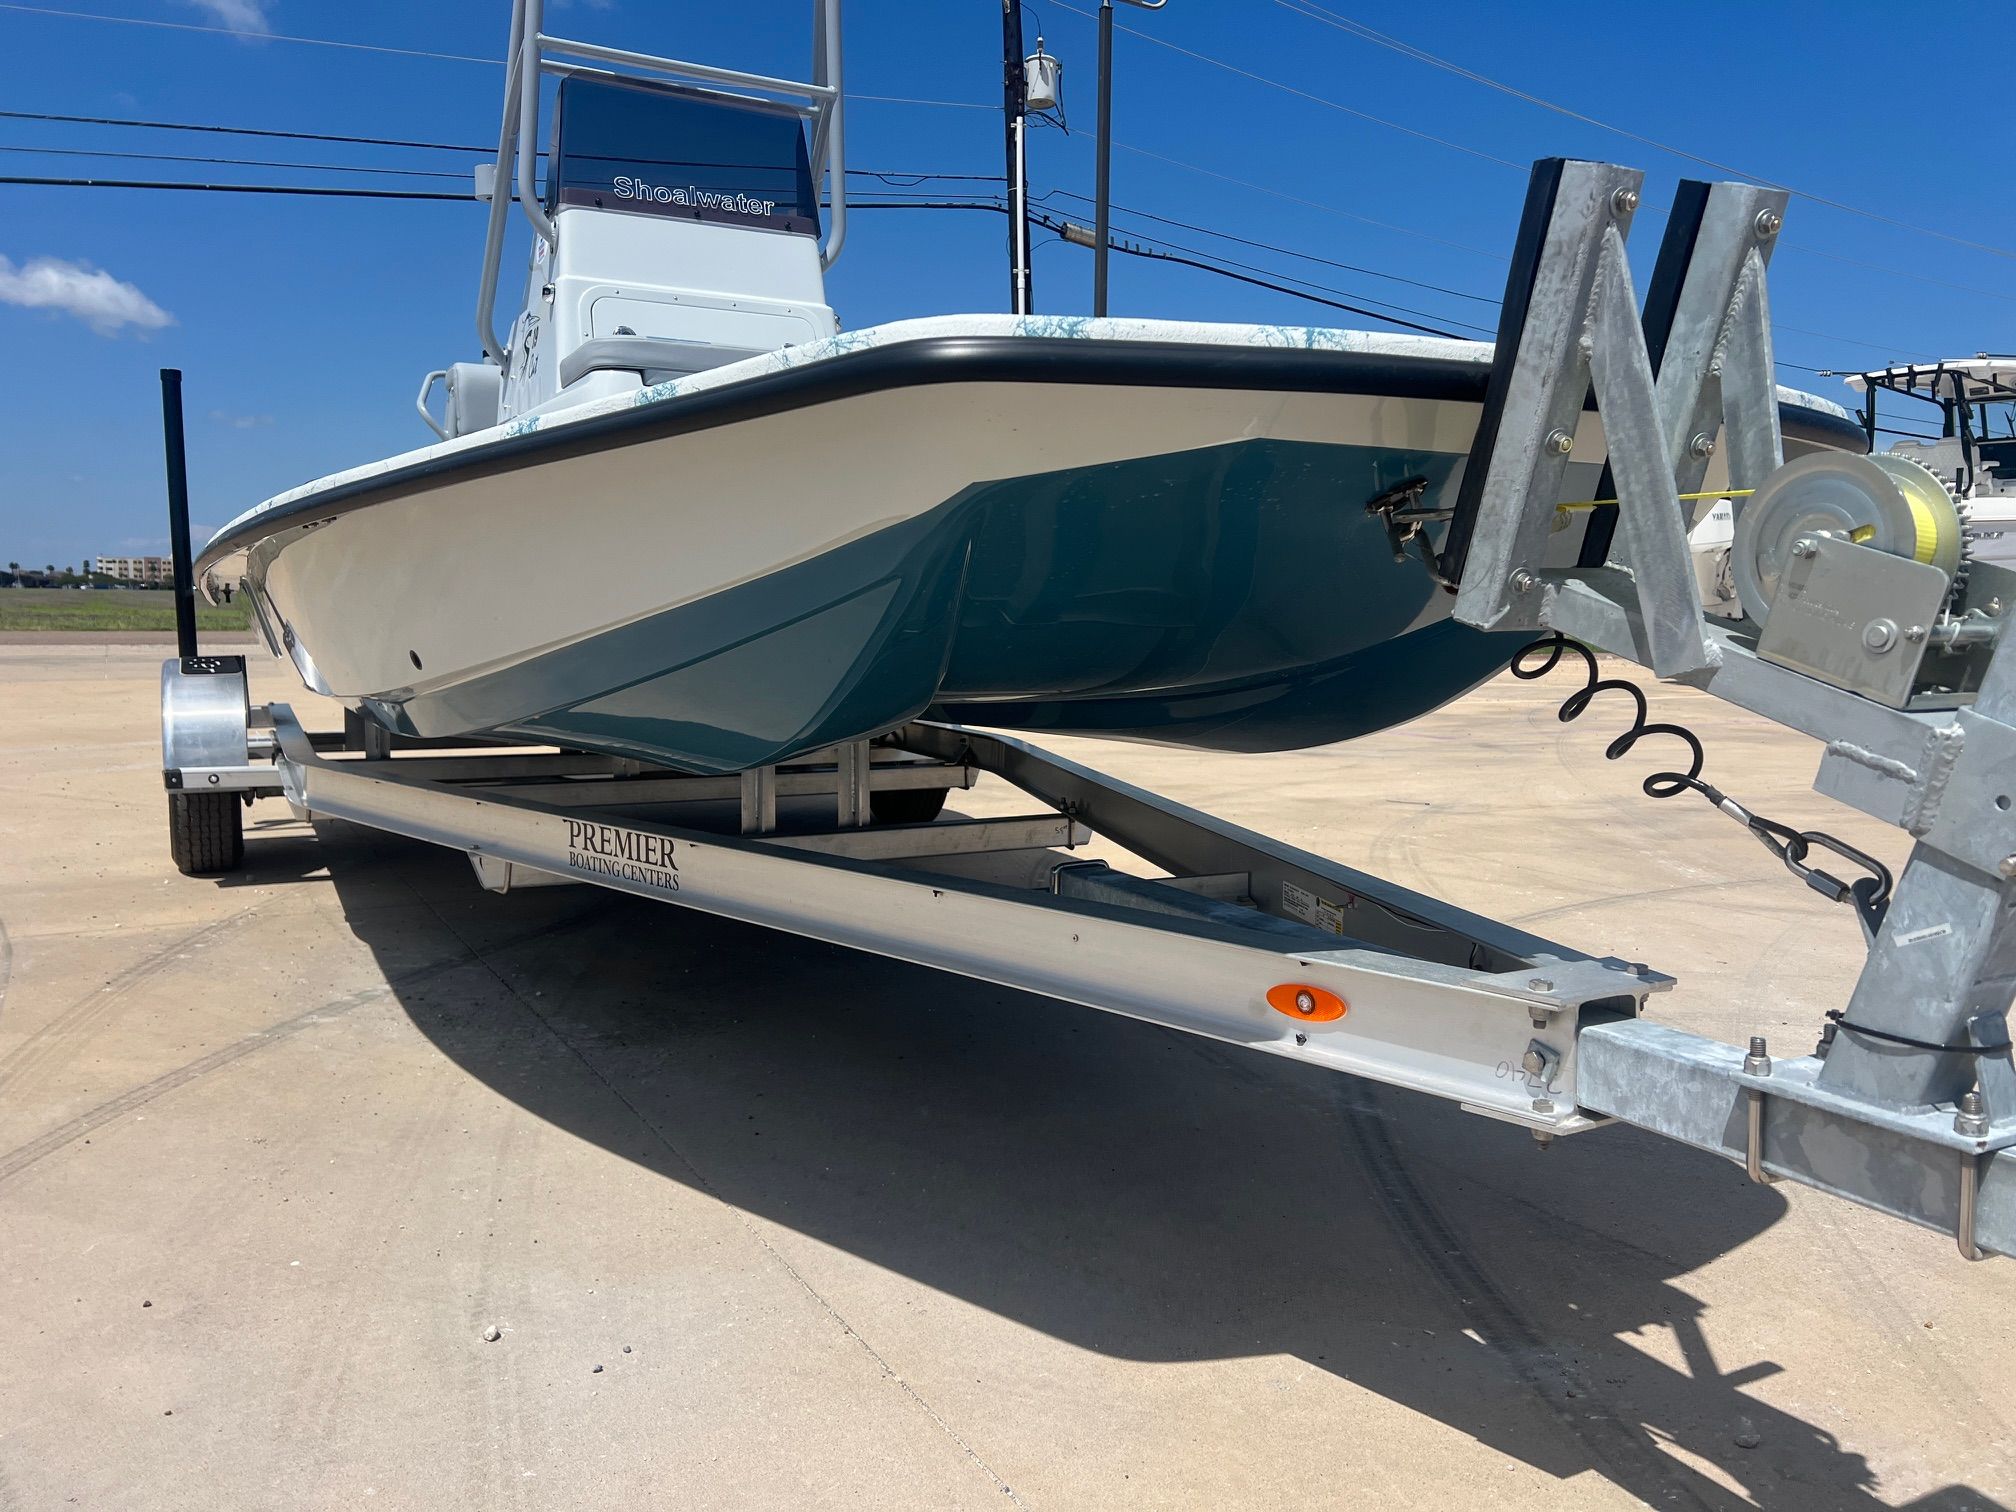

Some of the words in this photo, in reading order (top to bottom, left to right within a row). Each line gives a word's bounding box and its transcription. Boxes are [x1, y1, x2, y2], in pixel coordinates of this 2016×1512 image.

[613, 176, 775, 216] Shoalwater
[567, 820, 679, 871] PREMIER
[569, 851, 620, 878] BOATING
[622, 863, 680, 891] CENTERS
